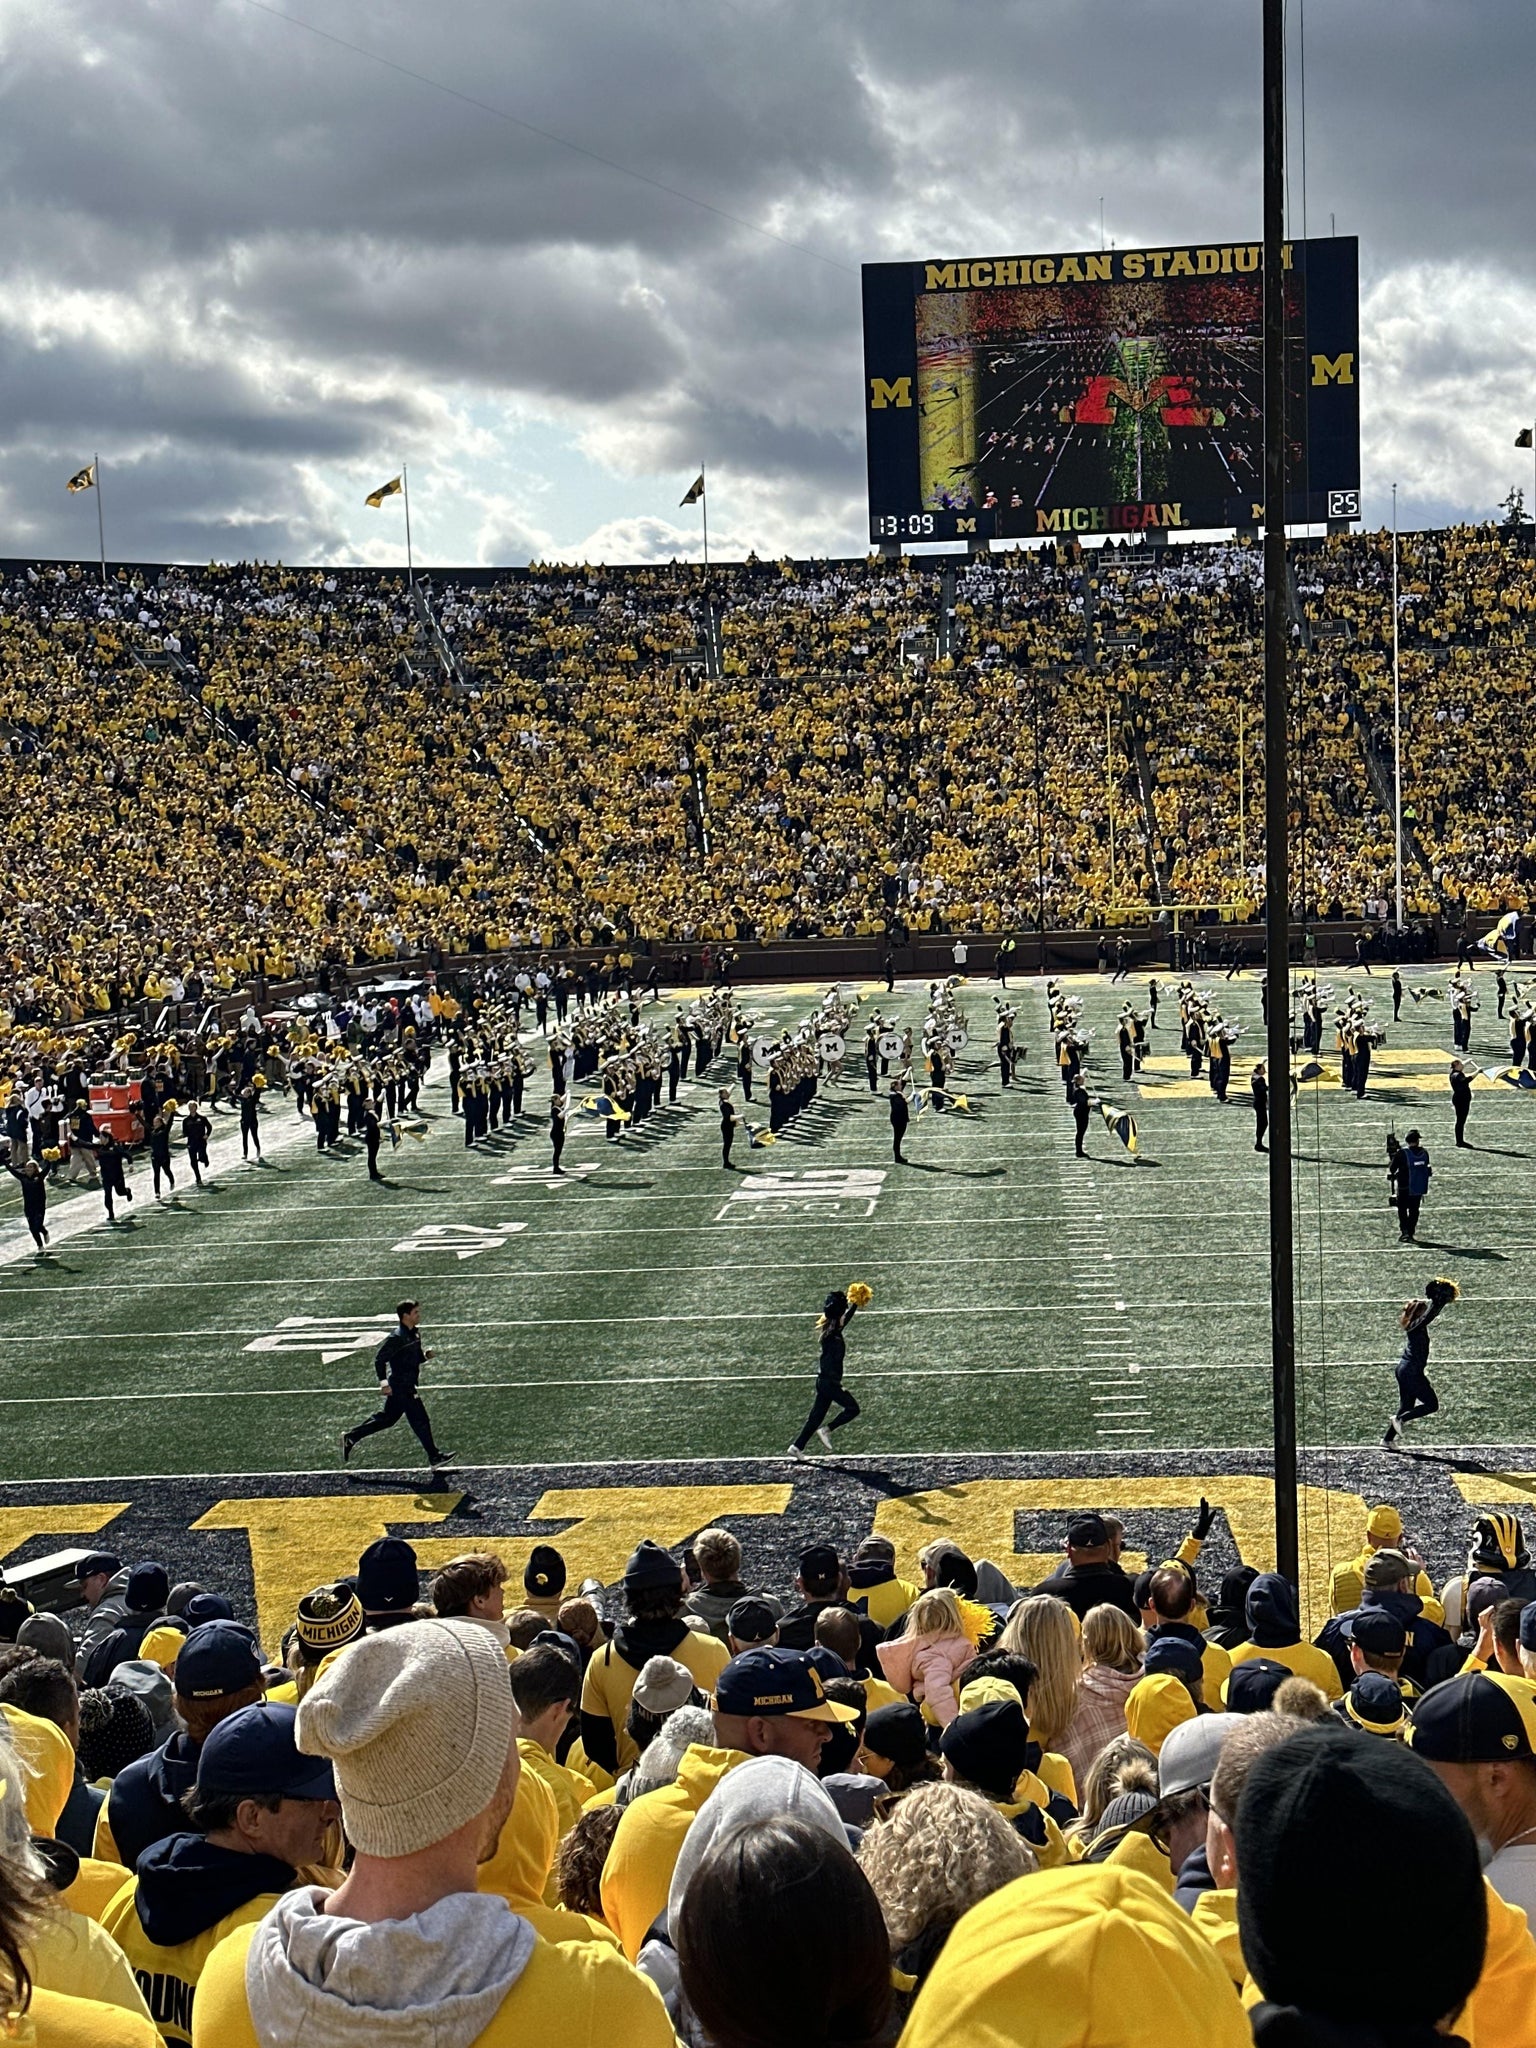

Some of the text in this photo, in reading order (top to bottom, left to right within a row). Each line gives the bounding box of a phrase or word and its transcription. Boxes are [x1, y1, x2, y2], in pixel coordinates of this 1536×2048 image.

[924, 255, 1113, 290] MICHIGAN
[1311, 353, 1354, 386] M
[870, 377, 912, 409] M
[1332, 493, 1358, 515] 25
[878, 514, 934, 536] 13:09
[955, 517, 977, 533] M
[1036, 503, 1182, 532] MICHIGAN
[825, 1042, 839, 1053] M
[885, 1041, 898, 1051] M
[951, 1034, 963, 1043] M
[390, 1222, 529, 1253] 20
[302, 1608, 361, 1641] MICHIGAN
[753, 1694, 794, 1706] MICHIGAN
[131, 1966, 196, 2036] OUN
